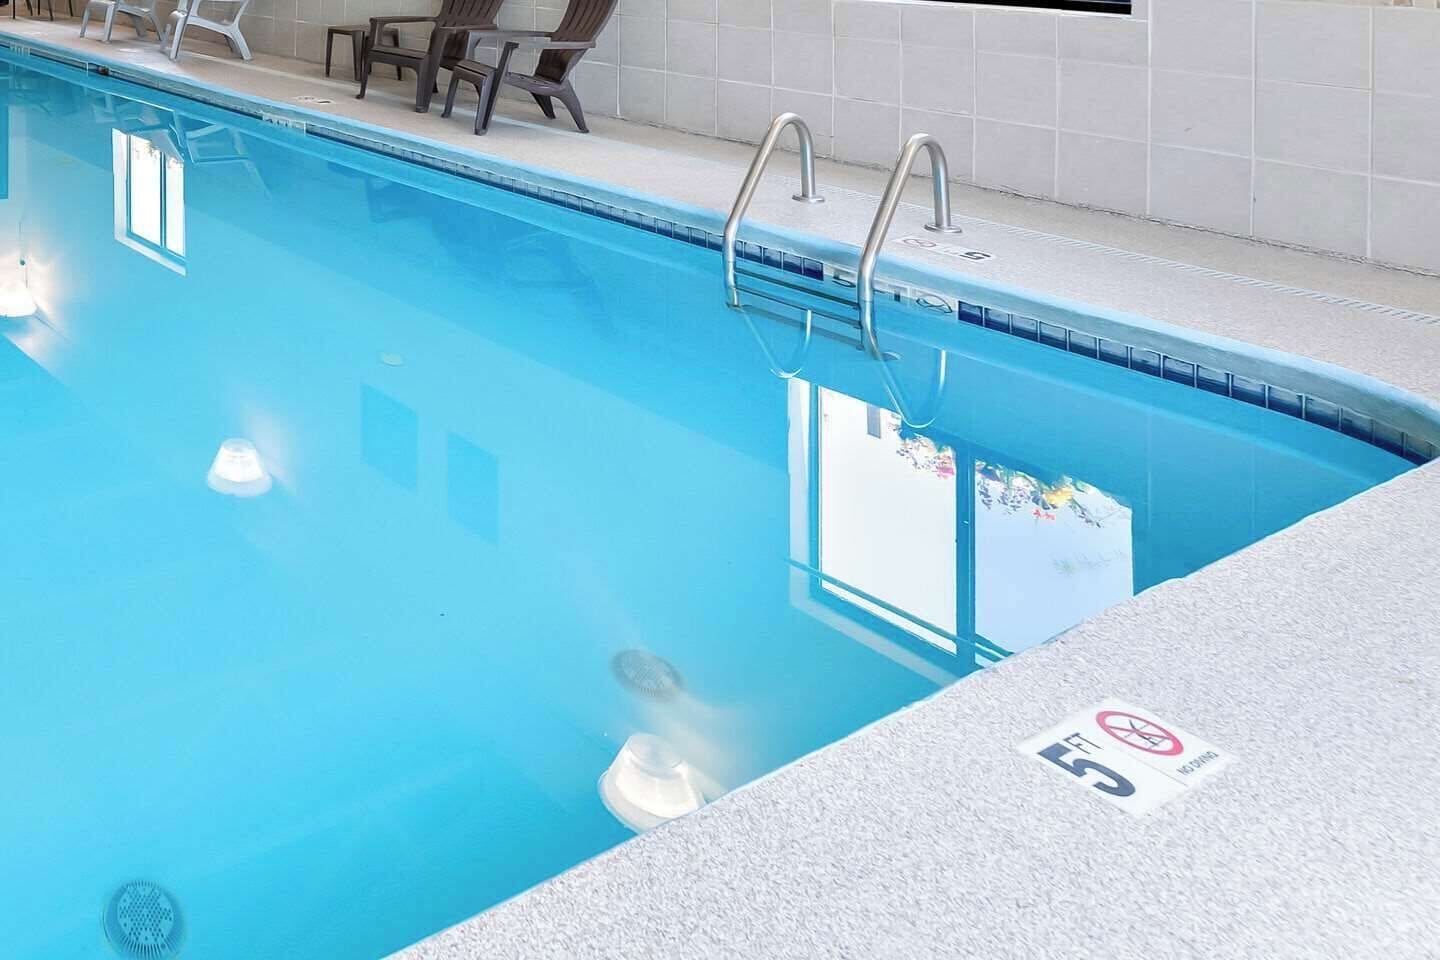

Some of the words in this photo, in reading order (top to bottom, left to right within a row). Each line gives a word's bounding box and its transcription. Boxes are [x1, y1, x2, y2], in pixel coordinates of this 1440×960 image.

[1063, 732, 1104, 755] FT
[1036, 742, 1136, 797] 5
[1176, 765, 1195, 776] NO
[1189, 751, 1220, 769] DIVING
